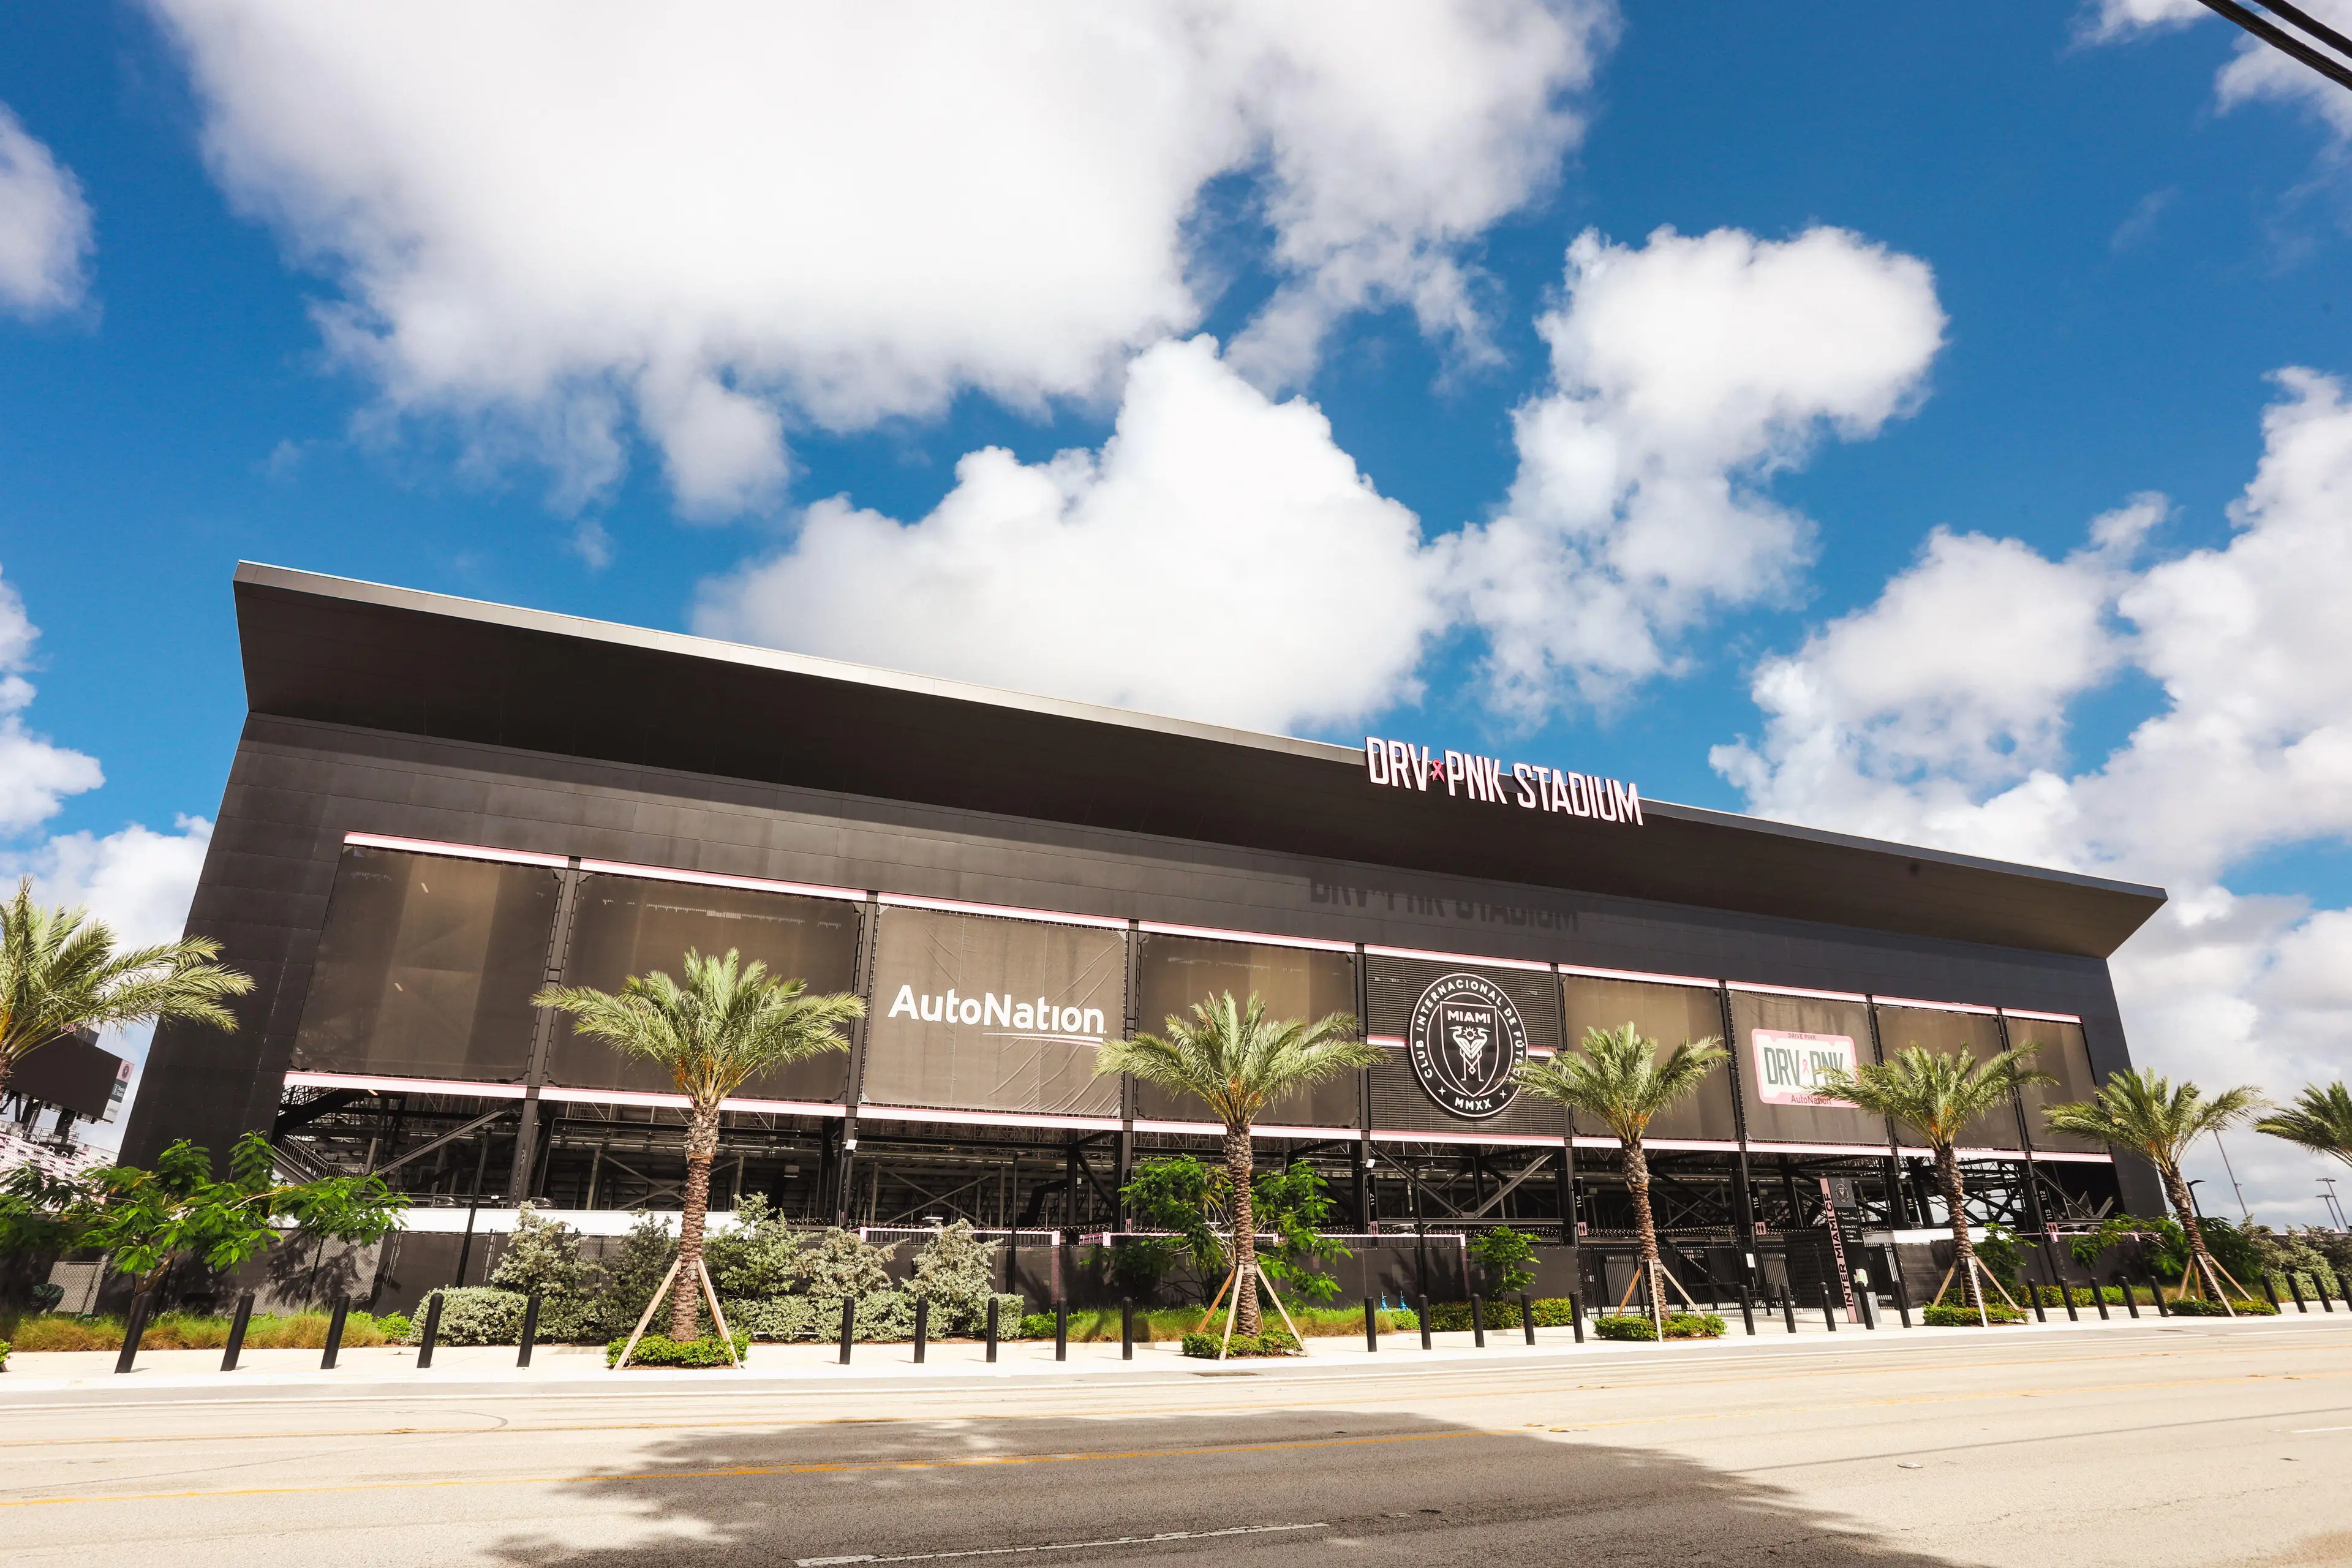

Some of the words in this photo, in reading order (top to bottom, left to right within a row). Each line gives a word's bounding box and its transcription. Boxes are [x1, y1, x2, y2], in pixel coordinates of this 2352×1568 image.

[1365, 736, 1429, 792] DRV
[1444, 749, 1508, 805] PNK
[1513, 762, 1644, 826] STADIUM
[888, 984, 1105, 1035] AutoNation
[1416, 979, 1502, 1031] INTERNACIONAL
[1447, 1009, 1491, 1024] MIAMI
[1504, 1008, 1518, 1026] DE
[1415, 1040, 1432, 1079] CLUB
[1763, 1047, 1800, 1086] DRV
[1454, 1096, 1492, 1110] MMXX
[1791, 1095, 1831, 1105] AutoNation
[1824, 1193, 1834, 1212] CF
[1828, 1215, 1844, 1259] MIAMI
[1838, 1263, 1855, 1308] INTER
